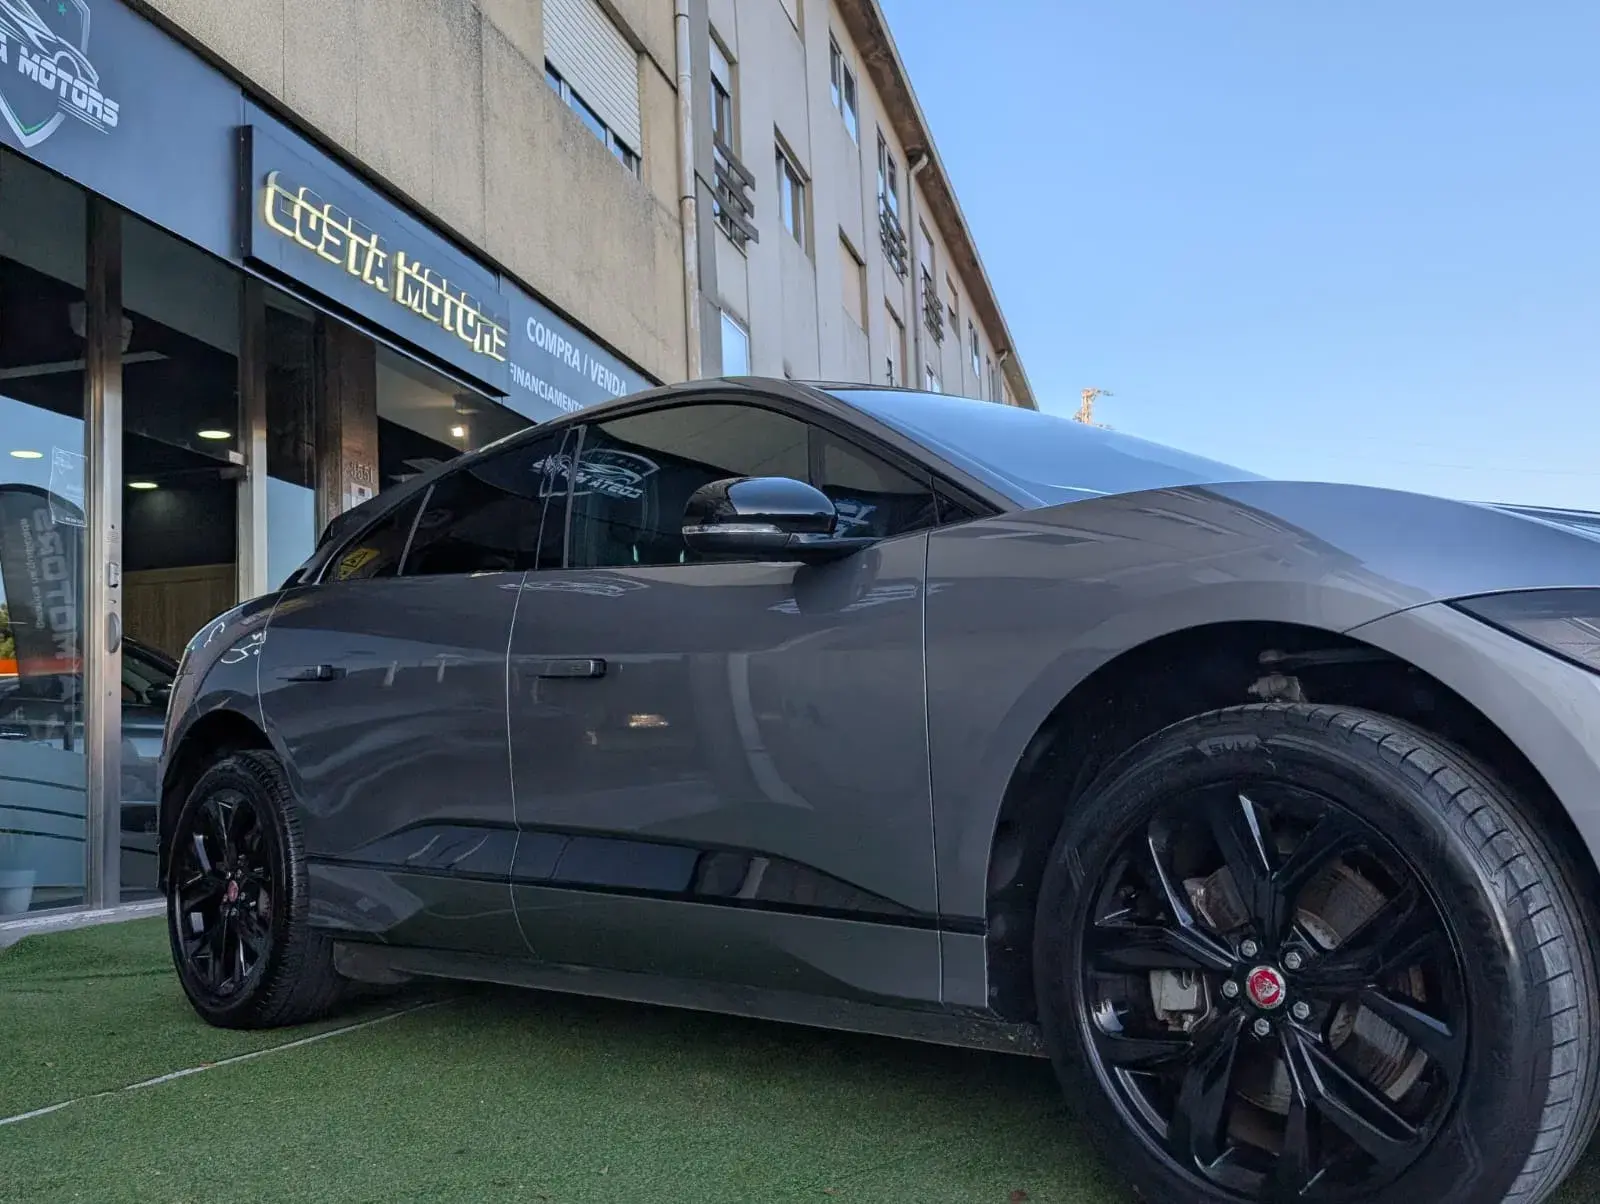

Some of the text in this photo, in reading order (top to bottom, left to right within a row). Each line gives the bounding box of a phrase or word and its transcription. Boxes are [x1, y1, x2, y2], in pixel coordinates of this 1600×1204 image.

[18, 45, 120, 128] MOTORS
[526, 316, 581, 374] COMPRA
[590, 357, 628, 397] VENDA
